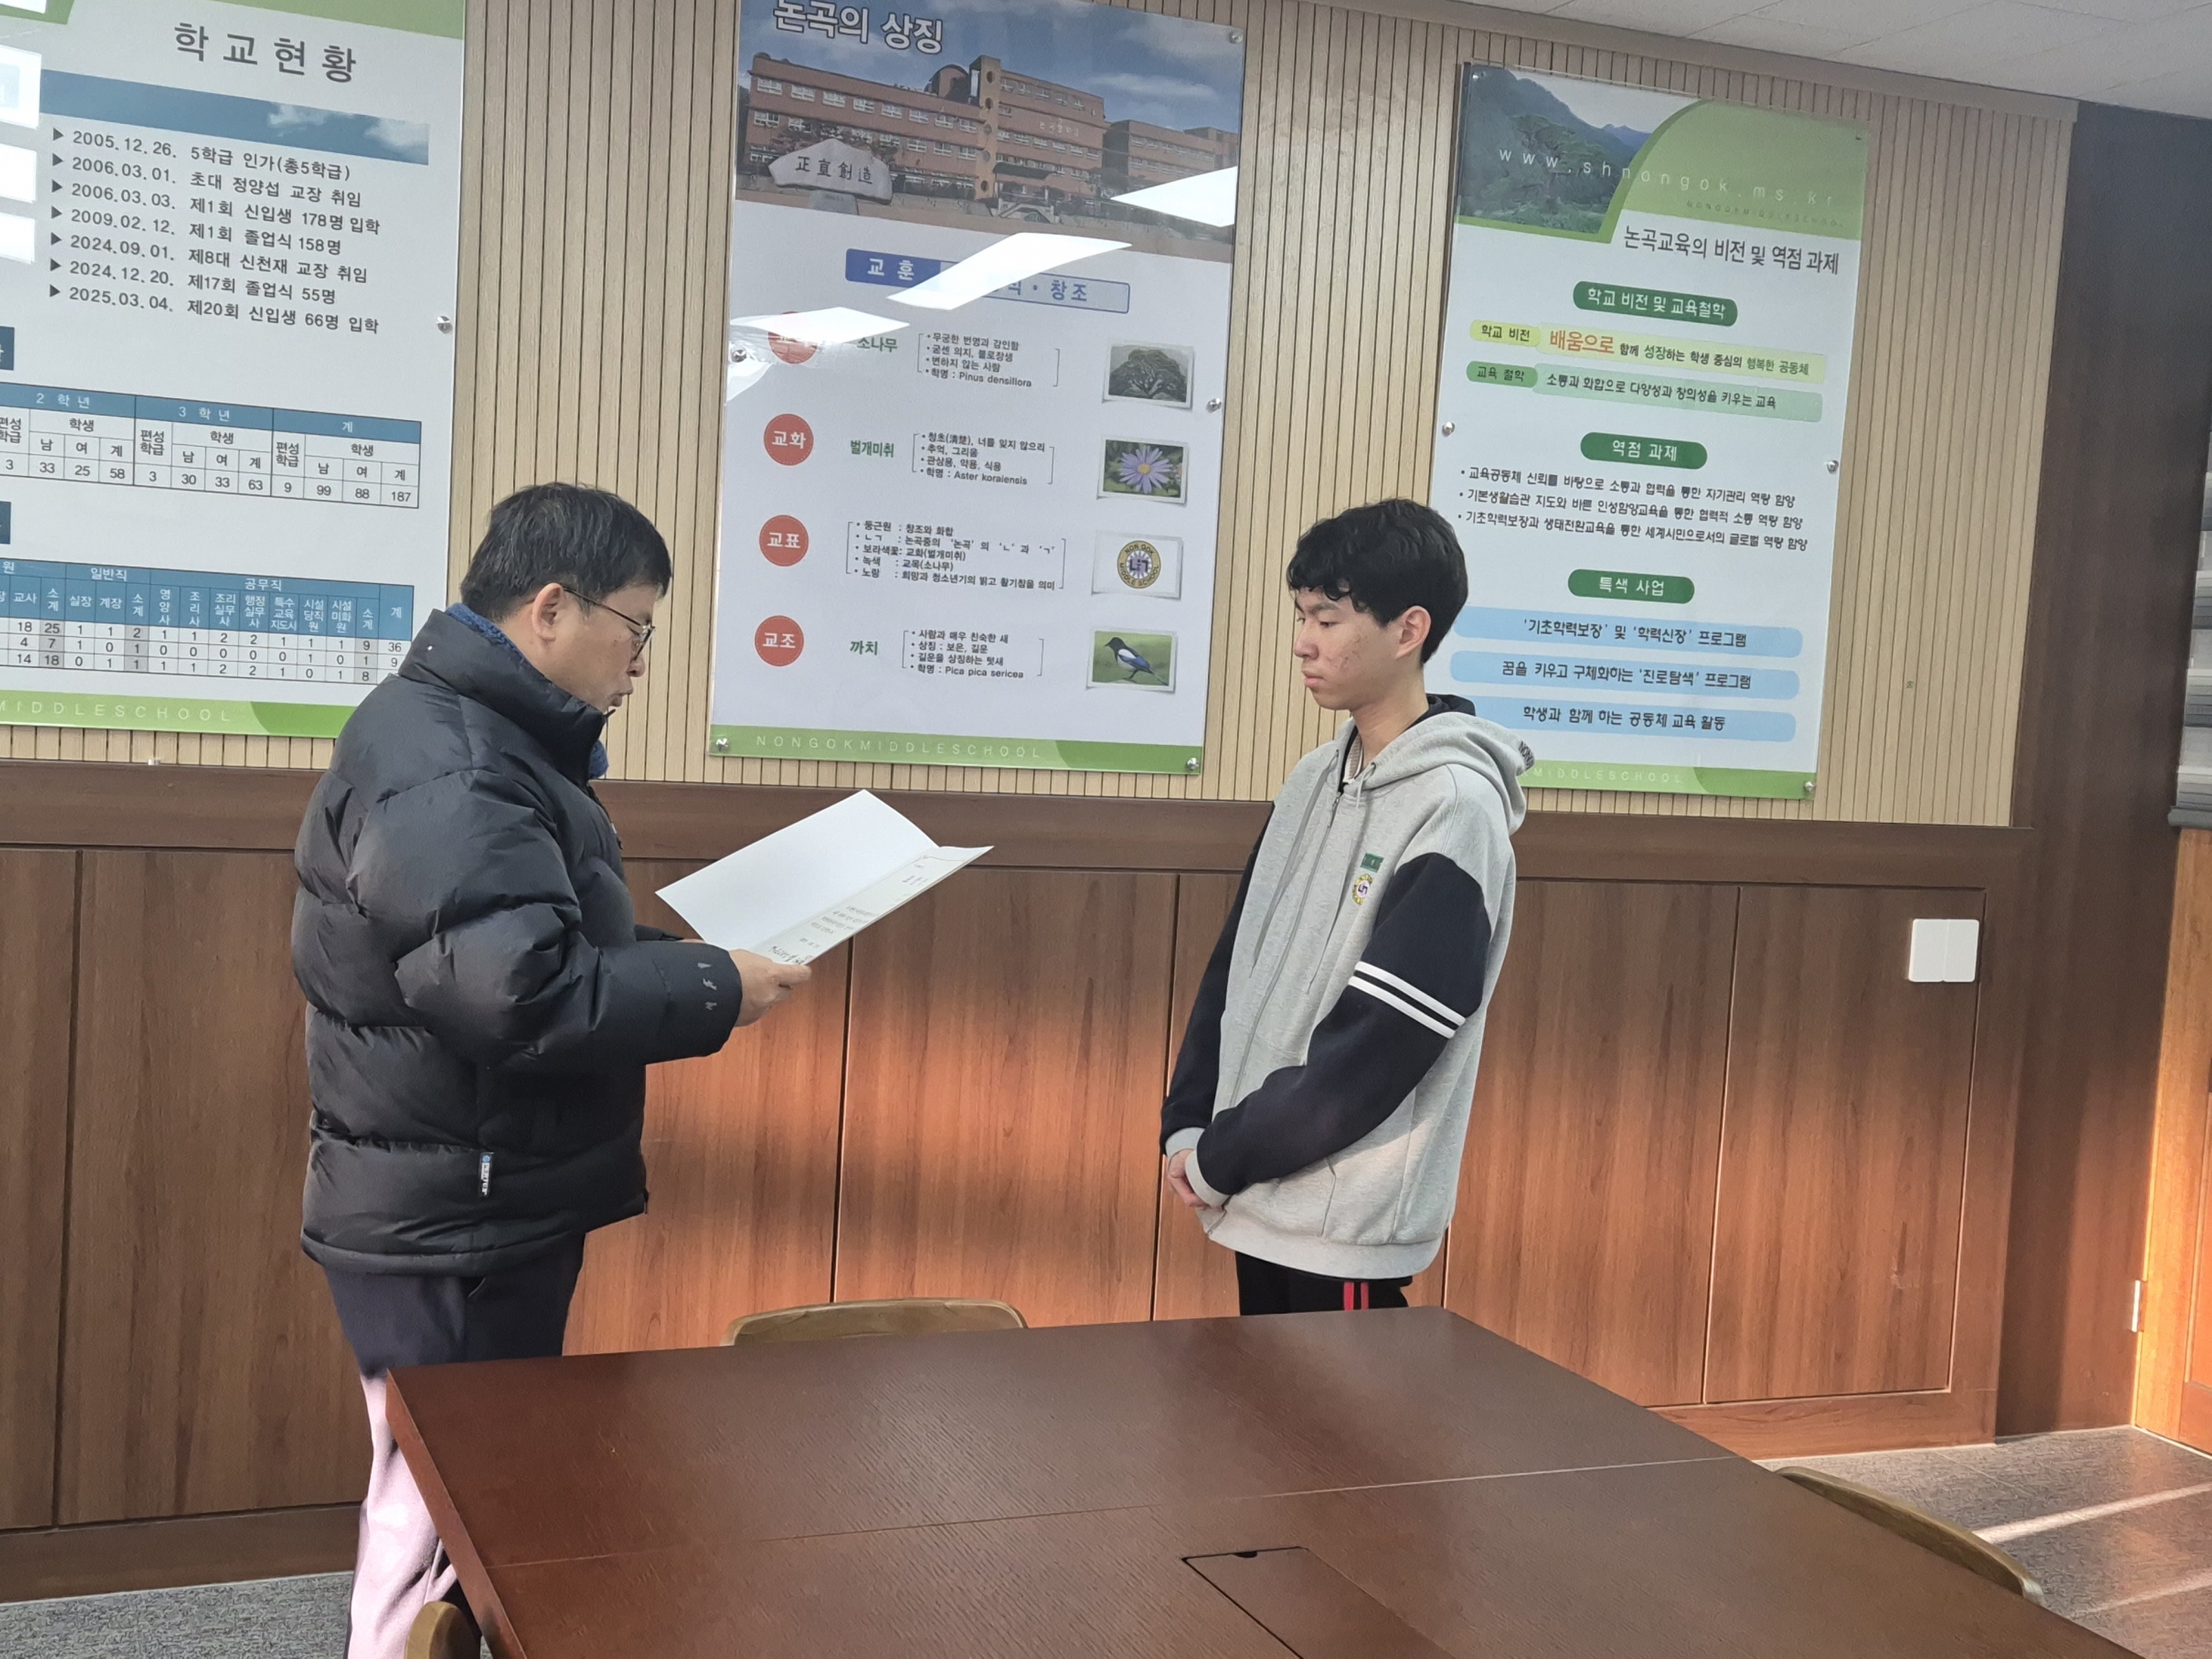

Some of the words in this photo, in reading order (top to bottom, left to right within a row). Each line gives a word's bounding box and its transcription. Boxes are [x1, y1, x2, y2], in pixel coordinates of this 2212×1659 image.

[773, 0, 869, 44] 논곡의
[881, 12, 944, 55] 상징
[191, 147, 234, 166] 5학급
[190, 172, 222, 190] 초대
[233, 176, 280, 197] 정양섭
[290, 185, 322, 204] 교장
[331, 188, 362, 208] 취임
[190, 197, 233, 217] 제1회
[244, 204, 292, 225] 신입생
[302, 212, 344, 232] 178명
[350, 217, 380, 235] 입학
[189, 223, 233, 242] 제1회
[244, 228, 292, 250] 졸업식
[298, 237, 342, 256] 158명
[1624, 225, 1709, 259] 논곡교육의
[1714, 238, 1747, 264] 비전
[1750, 244, 1766, 266] 및
[1771, 245, 1803, 271] 역점
[1806, 250, 1840, 275] 과제
[188, 249, 230, 268] 제8대
[240, 254, 288, 274] 신천재
[296, 261, 329, 280] 교장
[337, 265, 368, 284] 취임
[188, 273, 235, 294] 제17회
[245, 280, 293, 300] 졸업식
[302, 288, 336, 305] 55명
[1050, 280, 1088, 303] 창조
[1587, 288, 1617, 308] 학교
[1621, 292, 1648, 311] 비전
[1653, 296, 1667, 313] 및
[1671, 297, 1726, 320] 교육철학
[187, 299, 239, 319] 제20회
[249, 305, 296, 326] 신입생
[304, 313, 339, 331] 66명
[349, 317, 380, 334] 입학
[1481, 324, 1502, 339] 학교
[1509, 327, 1530, 342] 비전
[856, 336, 898, 353] 소나무
[1549, 329, 1616, 355] 배움으로
[1619, 342, 1640, 357] 함께
[1643, 343, 1686, 363] 성장하는
[1690, 350, 1710, 365] 학생
[1713, 353, 1743, 368] 중심의
[1778, 360, 1810, 376] 공동체
[959, 371, 985, 383] Pinus
[1477, 365, 1498, 380] 교육
[1547, 373, 1580, 389] 소통과
[1582, 376, 1627, 394] 화합으로
[1630, 381, 1674, 399] 다양성과
[1676, 387, 1717, 404] 창의성을
[1721, 391, 1754, 407] 키우는
[1755, 395, 1777, 410] 교육
[69, 418, 95, 432] 학생
[210, 430, 234, 444] 학생
[771, 429, 807, 449] 교화
[350, 443, 374, 457] 학생
[850, 439, 895, 458] 벌개미취
[1612, 440, 1641, 458] 역점
[1648, 444, 1678, 463] 과제
[39, 462, 56, 474] 33
[74, 465, 90, 477] 25
[110, 468, 126, 480] 58
[181, 473, 196, 485] 30
[215, 476, 230, 488] 33
[248, 479, 263, 491] 63
[317, 485, 332, 496] 99
[355, 488, 370, 500] 88
[391, 490, 411, 503] 187
[954, 470, 979, 481] Aster
[1469, 466, 1522, 484] 교육공동체
[1563, 475, 1605, 491] 바탕으로
[1705, 488, 1747, 504] 자기관리
[1775, 495, 1796, 509] 함양
[1535, 494, 1568, 510] 지도와
[1571, 497, 1593, 512] 바른
[1699, 508, 1729, 524] 협력적
[1783, 516, 1803, 530] 함양
[766, 531, 802, 549] 교표
[1465, 511, 1540, 530] 기초학력보장과
[1645, 526, 1725, 545] 세계시민으로서의
[1729, 533, 1759, 548] 글로벌
[1787, 537, 1809, 552] 함양
[90, 568, 127, 581] 일반직
[244, 578, 282, 592] 공무직
[1599, 576, 1629, 594] 특색
[1635, 580, 1665, 596] 사업
[13, 592, 37, 604] 교사
[44, 622, 60, 634] 25
[1615, 625, 1626, 640] 및
[1698, 630, 1747, 648] 프로그램
[762, 633, 796, 649] 교조
[849, 640, 879, 657] 까치
[945, 665, 965, 676] Pica
[968, 666, 988, 678] pica
[1502, 661, 1528, 678] 꿈을
[1534, 663, 1568, 680] 키우고
[1573, 664, 1634, 684] 구체화하는
[1704, 672, 1752, 690] 프로그램
[1523, 705, 1561, 723] 학생과
[1569, 708, 1594, 724] 함께
[1598, 710, 1623, 726] 하는
[1629, 711, 1668, 728] 공동체
[1672, 713, 1696, 730] 교육
[1701, 715, 1726, 732] 활동
